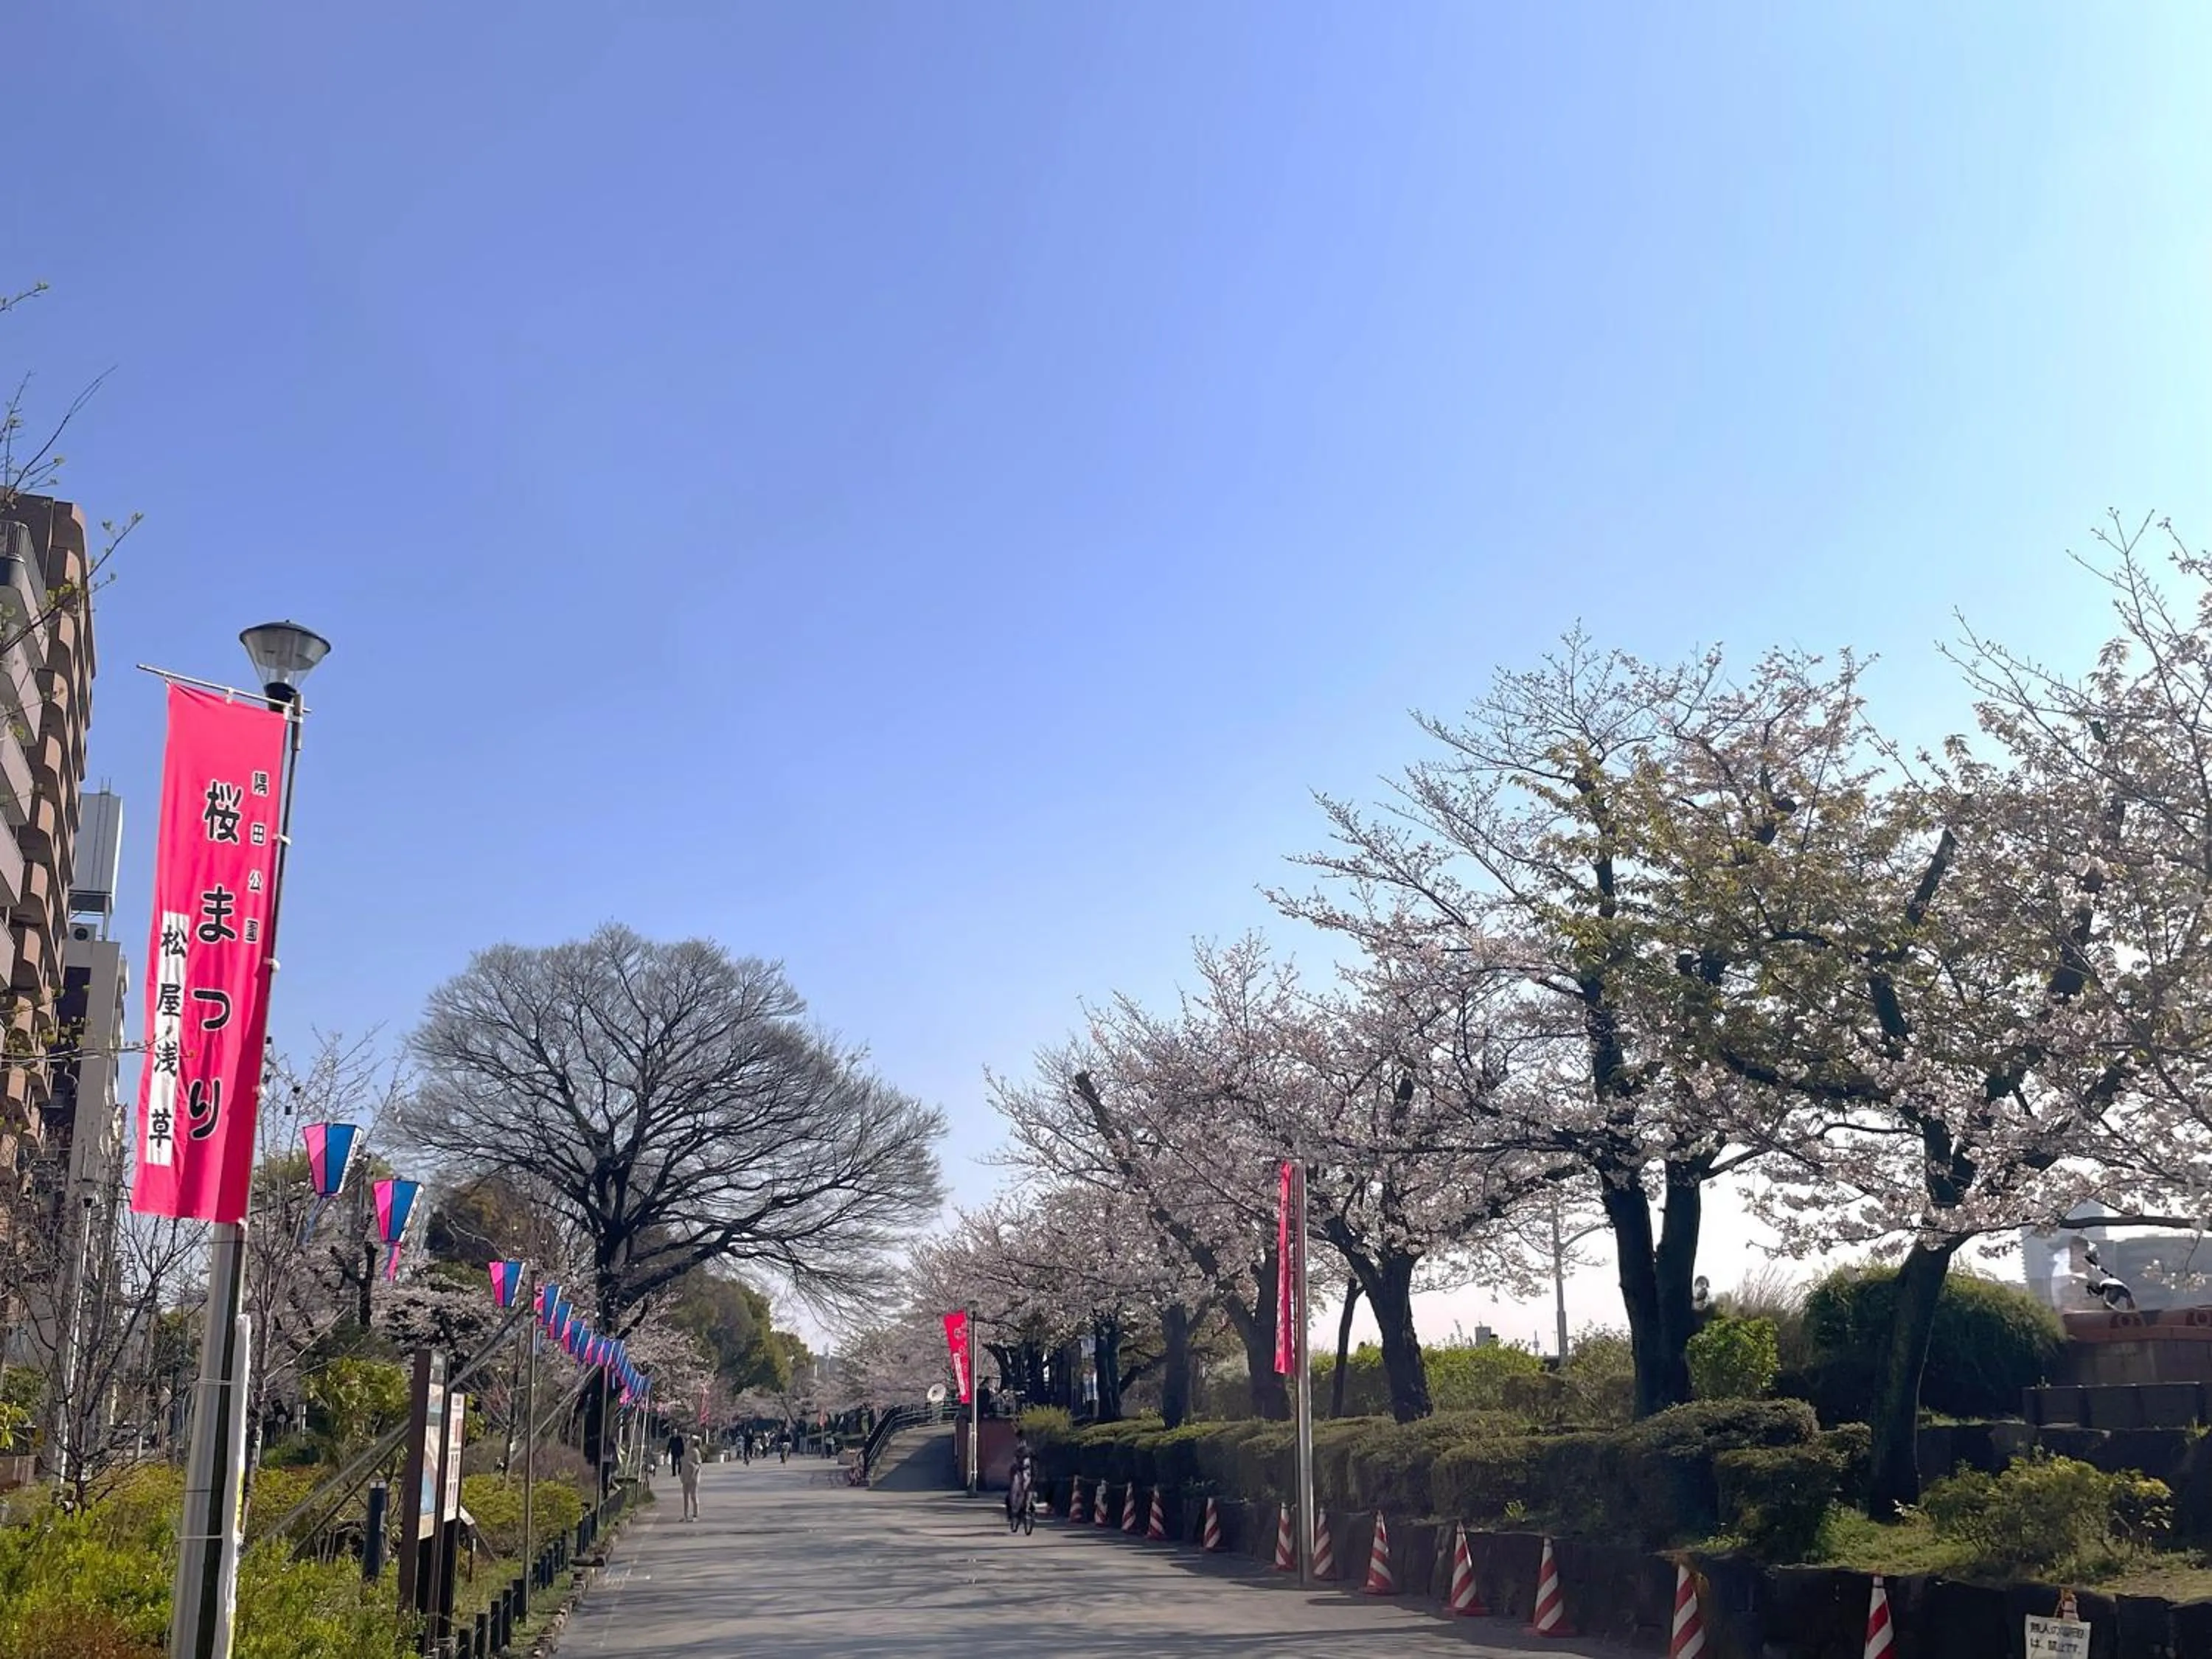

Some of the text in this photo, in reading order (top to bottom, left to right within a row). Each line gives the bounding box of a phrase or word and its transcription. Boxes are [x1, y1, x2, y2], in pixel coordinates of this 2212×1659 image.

[147, 923, 187, 1146] 松屋浅草
[189, 780, 245, 1139] 桜まつり
